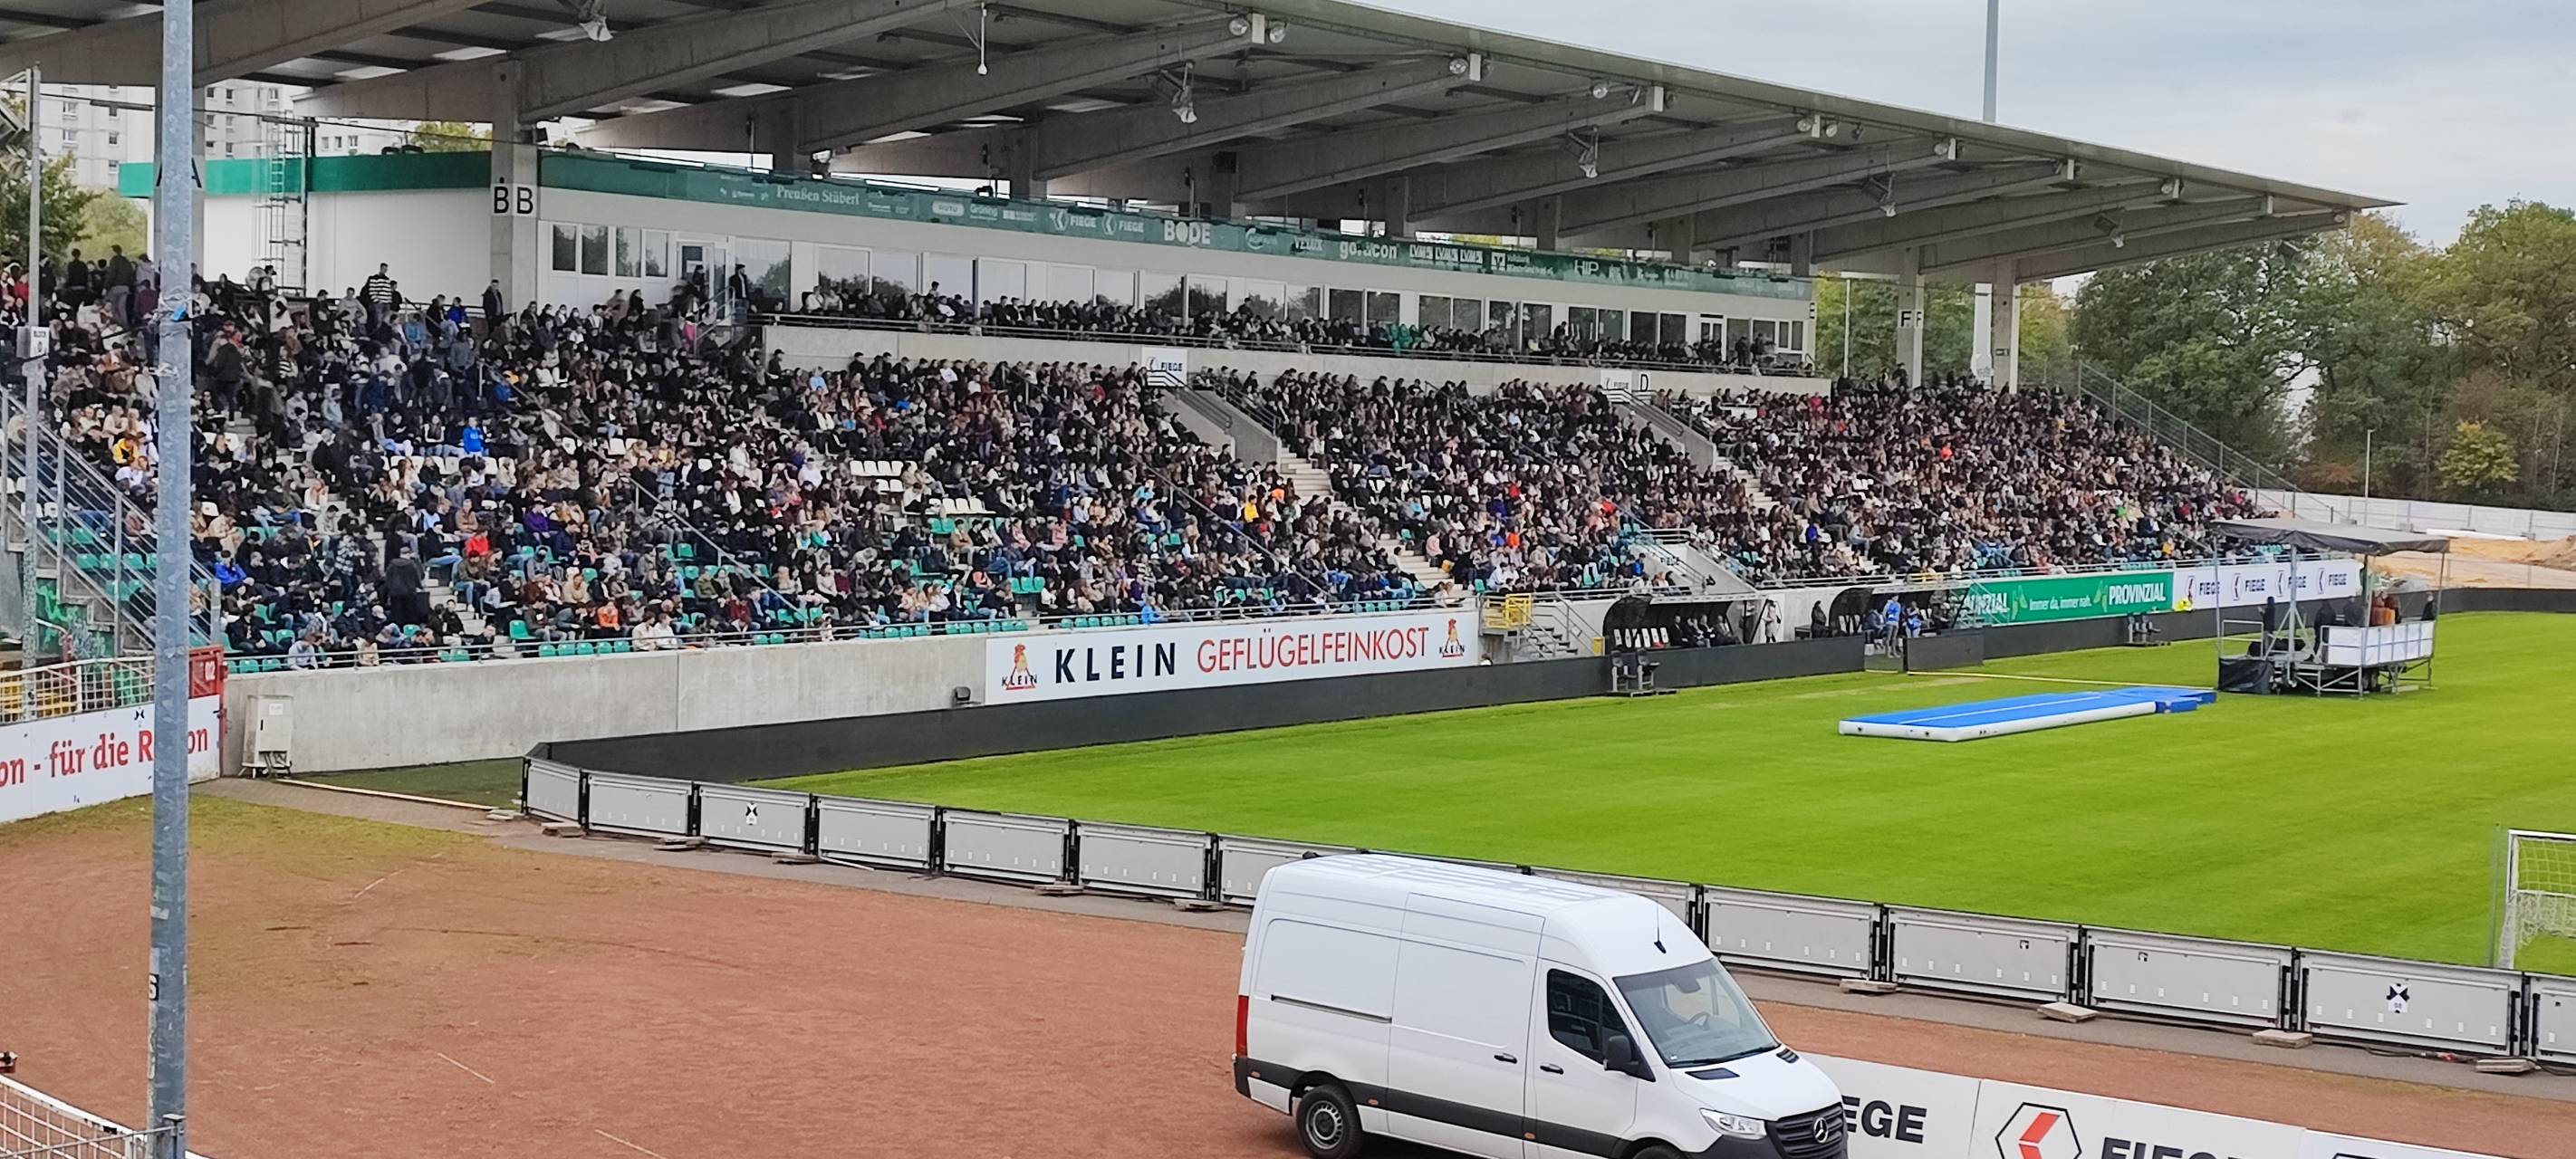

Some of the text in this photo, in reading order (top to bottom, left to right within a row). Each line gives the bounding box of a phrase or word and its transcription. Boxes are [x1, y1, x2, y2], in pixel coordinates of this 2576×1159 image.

[494, 187, 509, 214] B
[517, 187, 533, 215] B
[776, 185, 860, 206] Preußen Stüberl
[1070, 215, 1097, 228] FIEGE
[1119, 220, 1144, 233] FIEGE
[1164, 219, 1211, 244] BODE
[1900, 311, 1912, 327] F
[1160, 361, 1183, 371] FIEGE
[1640, 373, 1648, 392] D
[2199, 581, 2220, 596] FIEGE
[2245, 579, 2266, 592] FIEGE
[2329, 573, 2348, 587] FIEGE
[2109, 582, 2167, 606] PROVINZIAL
[1054, 627, 1429, 685] KLEIN GEFLÜGELFEINKOST
[205, 661, 216, 681] 02
[1001, 674, 1038, 686] KLEIN
[50, 739, 86, 778] für
[93, 732, 130, 771] die
[139, 727, 208, 763] Ron
